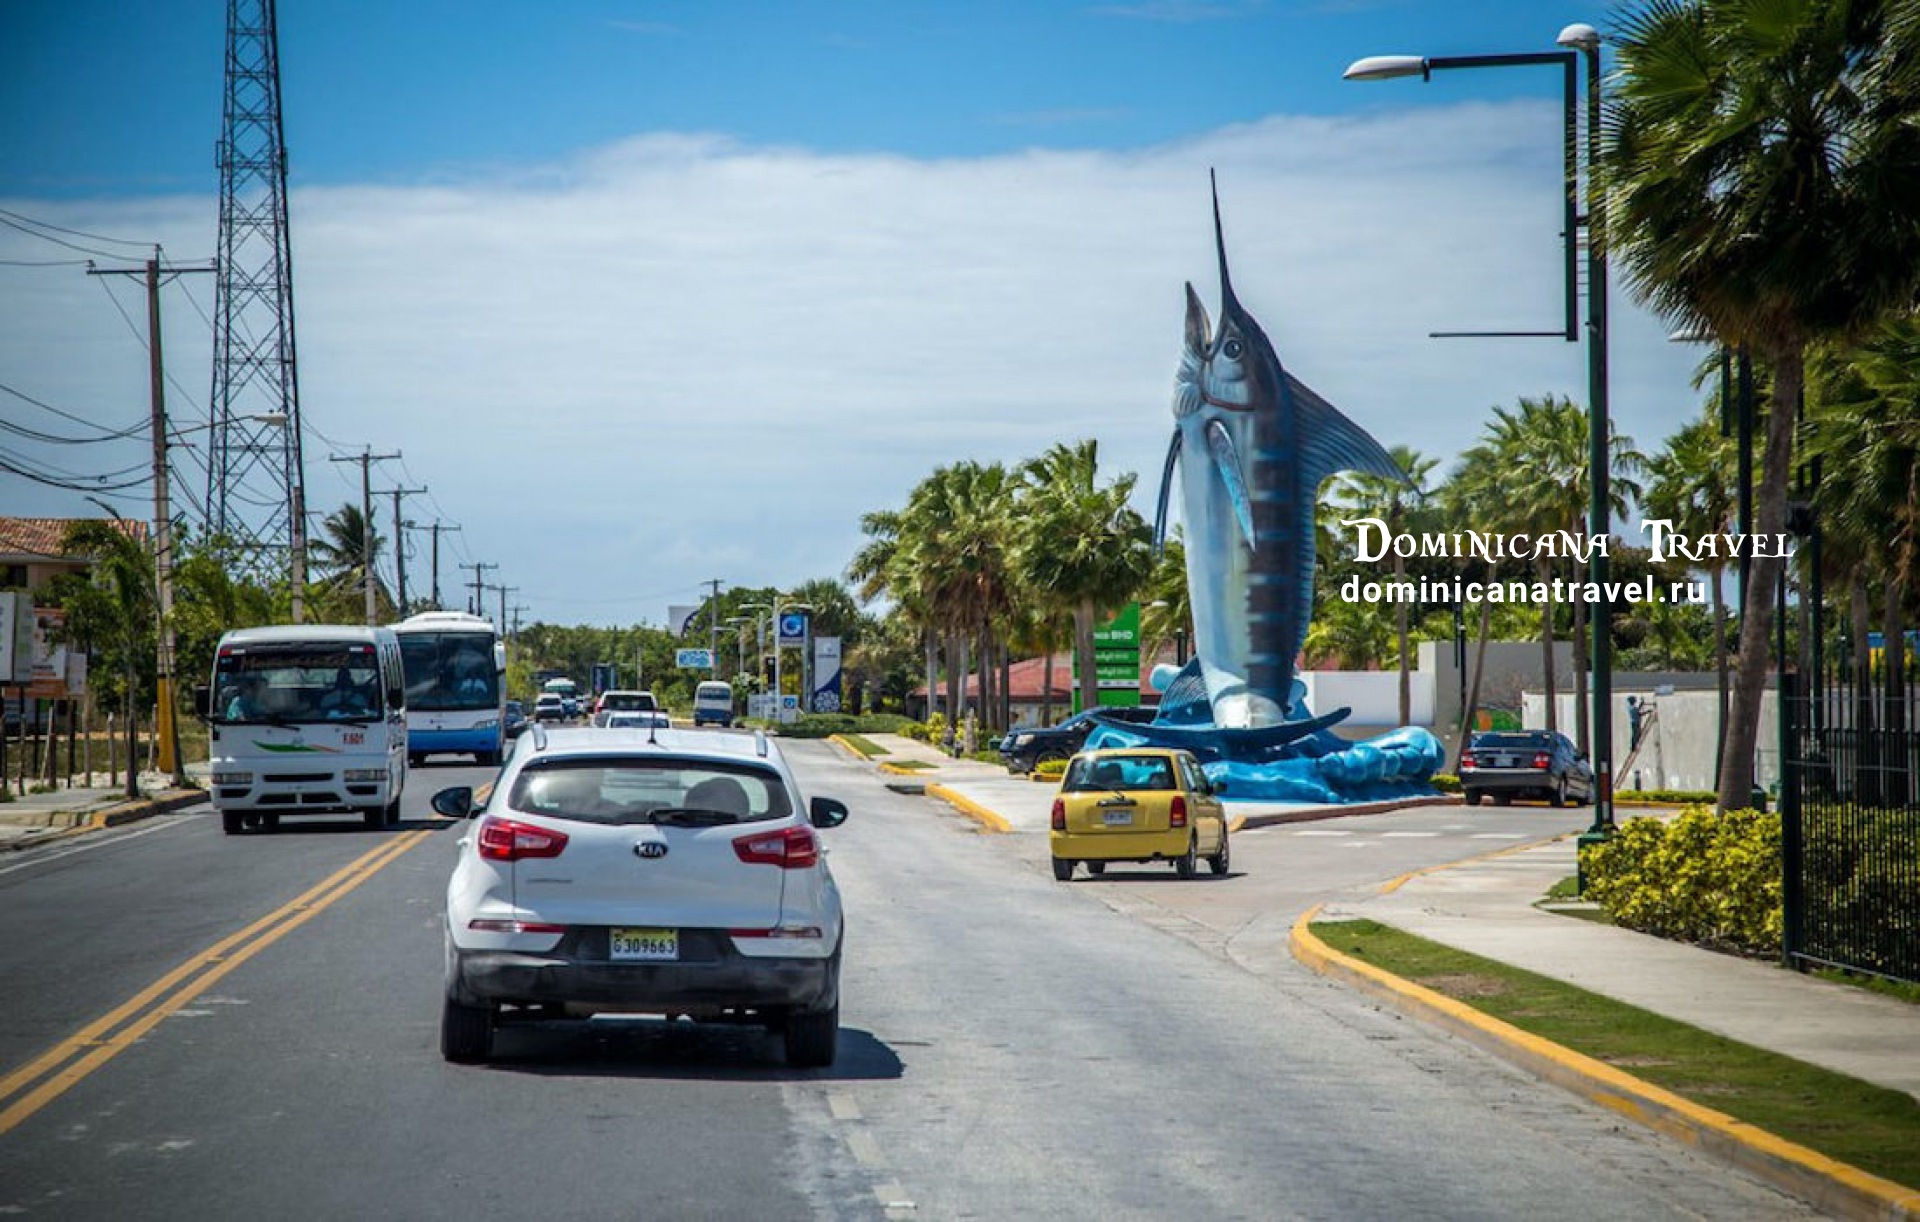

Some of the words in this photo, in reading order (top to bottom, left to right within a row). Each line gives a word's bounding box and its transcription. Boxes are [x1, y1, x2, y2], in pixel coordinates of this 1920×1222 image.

[1111, 629, 1134, 640] BHD
[638, 842, 664, 856] KIA
[614, 938, 675, 954] G309663
